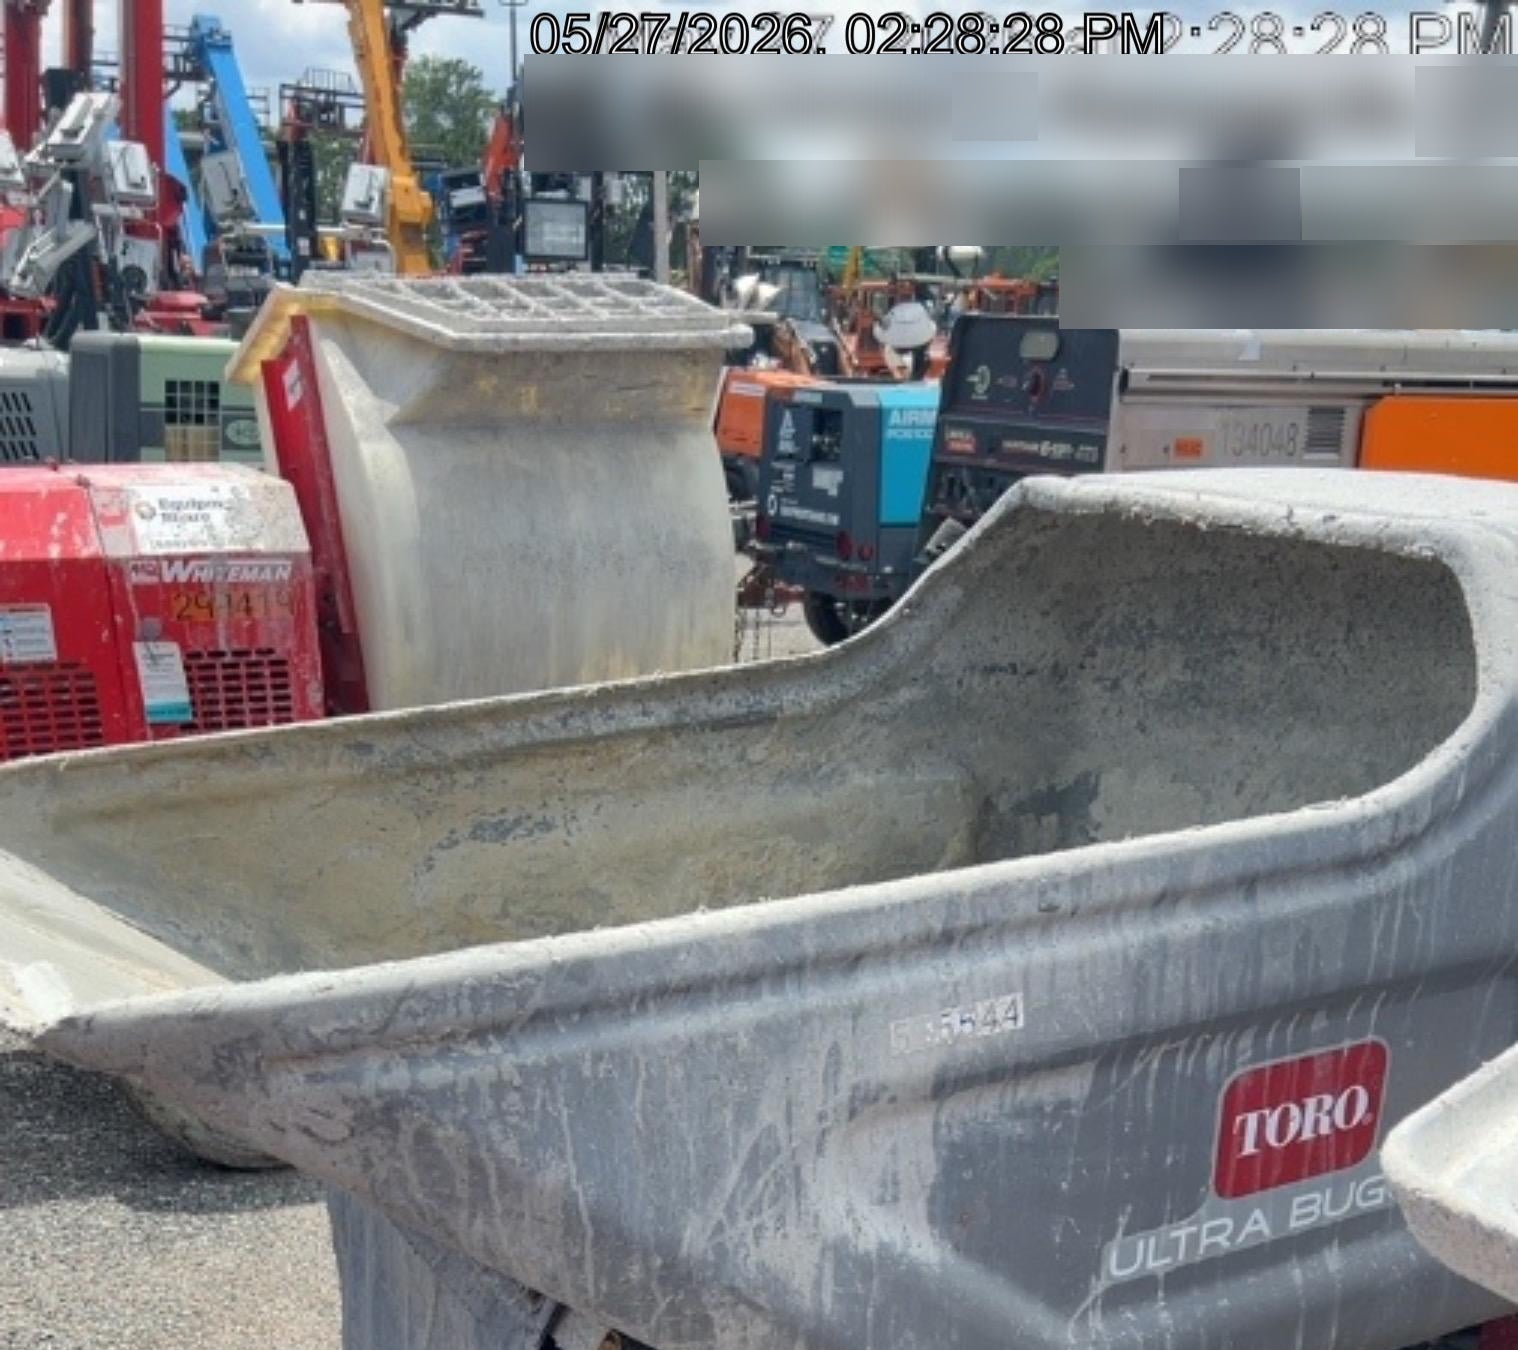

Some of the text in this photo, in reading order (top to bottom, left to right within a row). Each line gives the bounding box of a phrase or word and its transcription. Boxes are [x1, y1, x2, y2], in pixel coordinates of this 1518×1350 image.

[1233, 1085, 1369, 1158] TORO
[1109, 1175, 1392, 1276] ULTRA BUG
